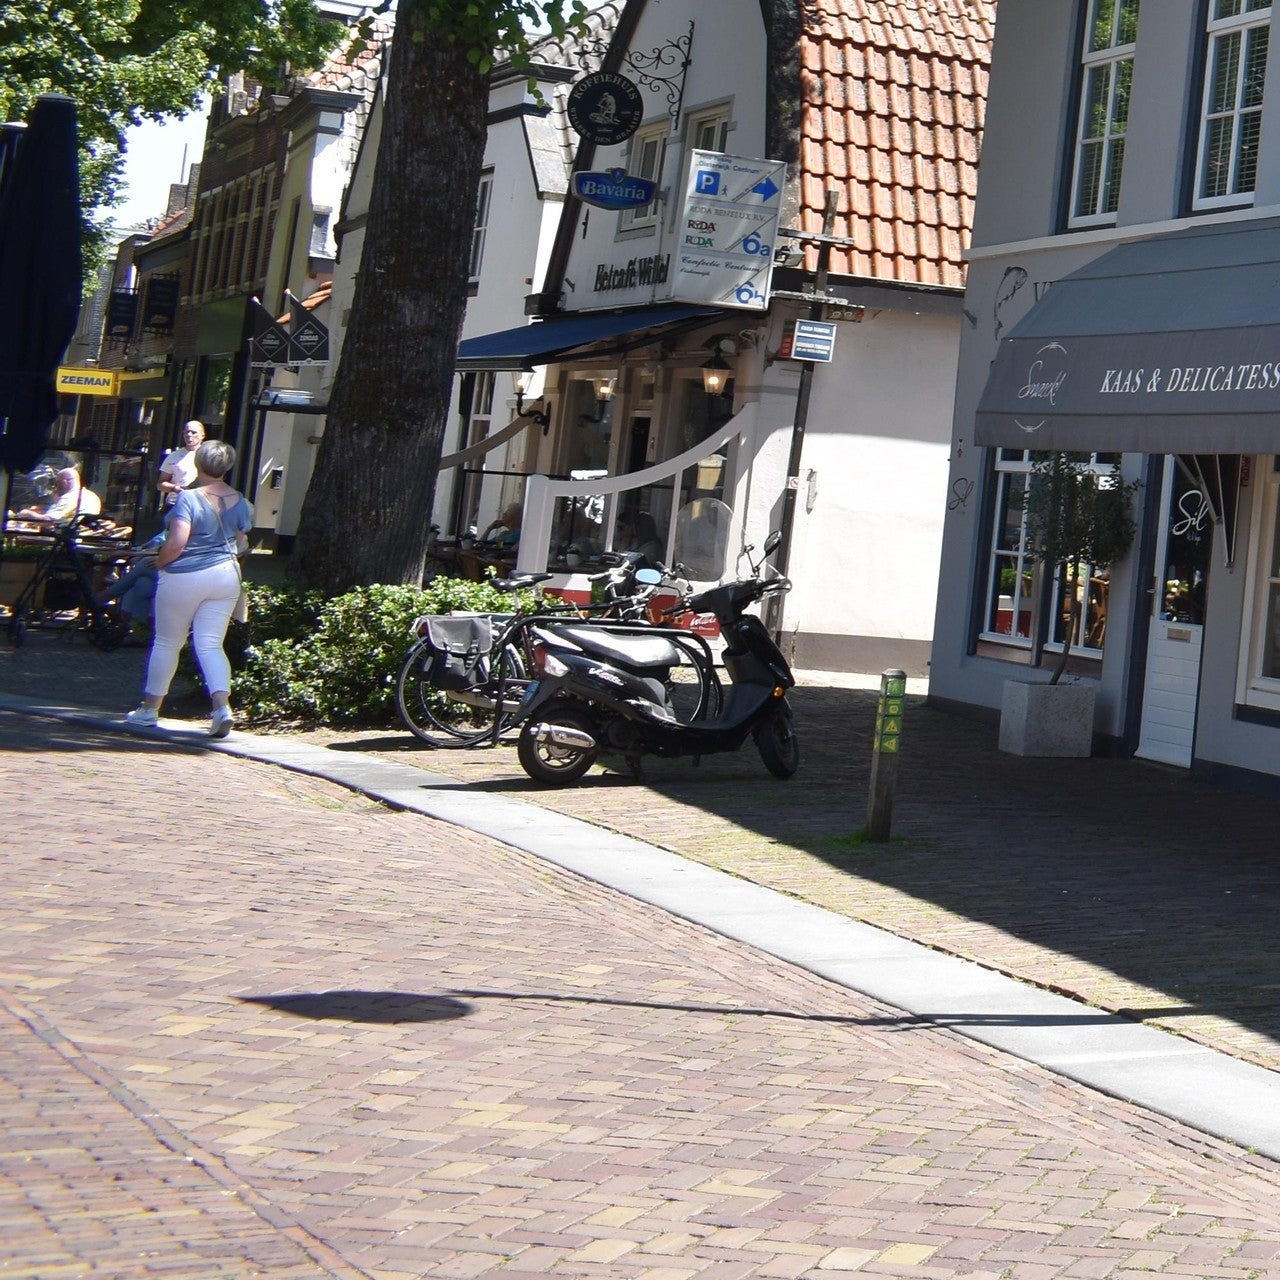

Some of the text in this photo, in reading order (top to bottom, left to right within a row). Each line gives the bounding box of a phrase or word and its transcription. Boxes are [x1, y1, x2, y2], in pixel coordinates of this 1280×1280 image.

[573, 73, 638, 100] KOFFIEHUIS
[583, 181, 646, 200] Bavaria
[701, 174, 715, 190] P
[714, 206, 750, 219] BENELUX
[742, 231, 770, 257] 6a
[61, 375, 111, 387] ZEEMAN
[1099, 368, 1144, 394] KAAS
[1146, 367, 1162, 393] &
[1172, 489, 1209, 536] Sil
